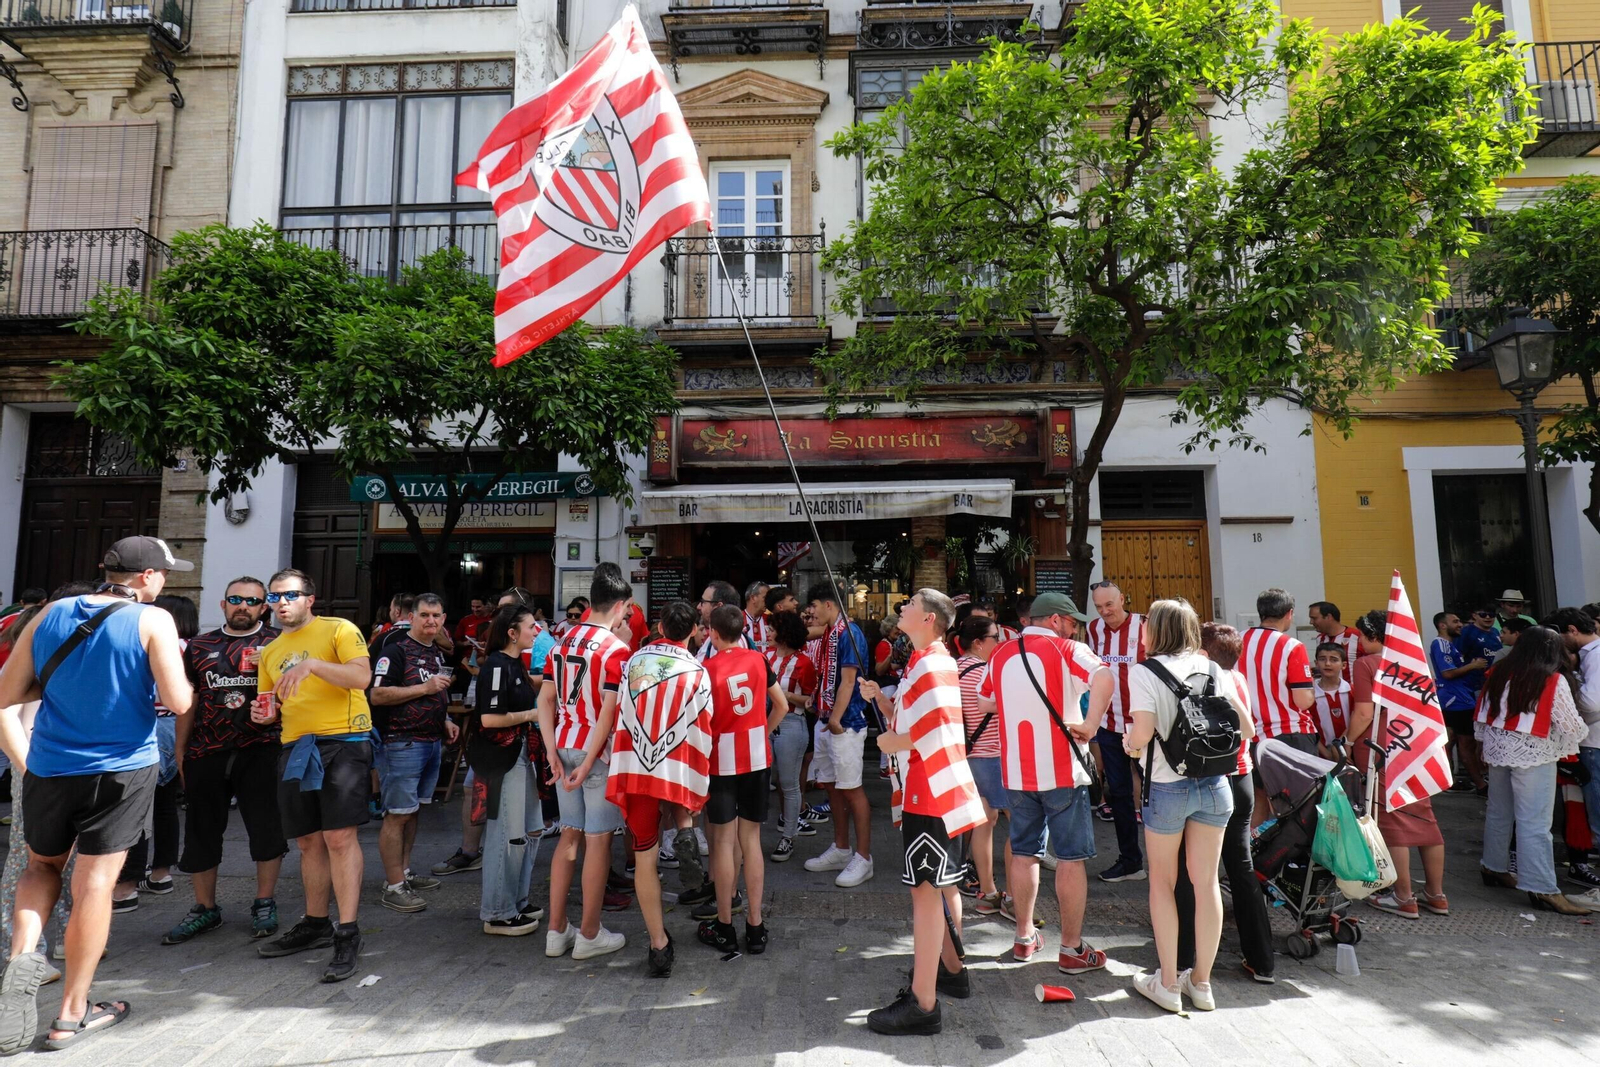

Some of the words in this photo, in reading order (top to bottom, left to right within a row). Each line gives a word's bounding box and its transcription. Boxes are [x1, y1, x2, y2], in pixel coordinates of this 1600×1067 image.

[828, 431, 941, 449] Sacristia
[389, 503, 465, 517] AVARO
[470, 502, 544, 517] PEREGIL
[679, 503, 698, 517] BAR
[789, 502, 802, 515] LA
[953, 493, 973, 507] BAR
[1360, 495, 1369, 506] 16
[1252, 532, 1263, 543] 18
[205, 671, 258, 689] Kutxaban
[553, 654, 588, 706] 17
[727, 672, 753, 716] 5
